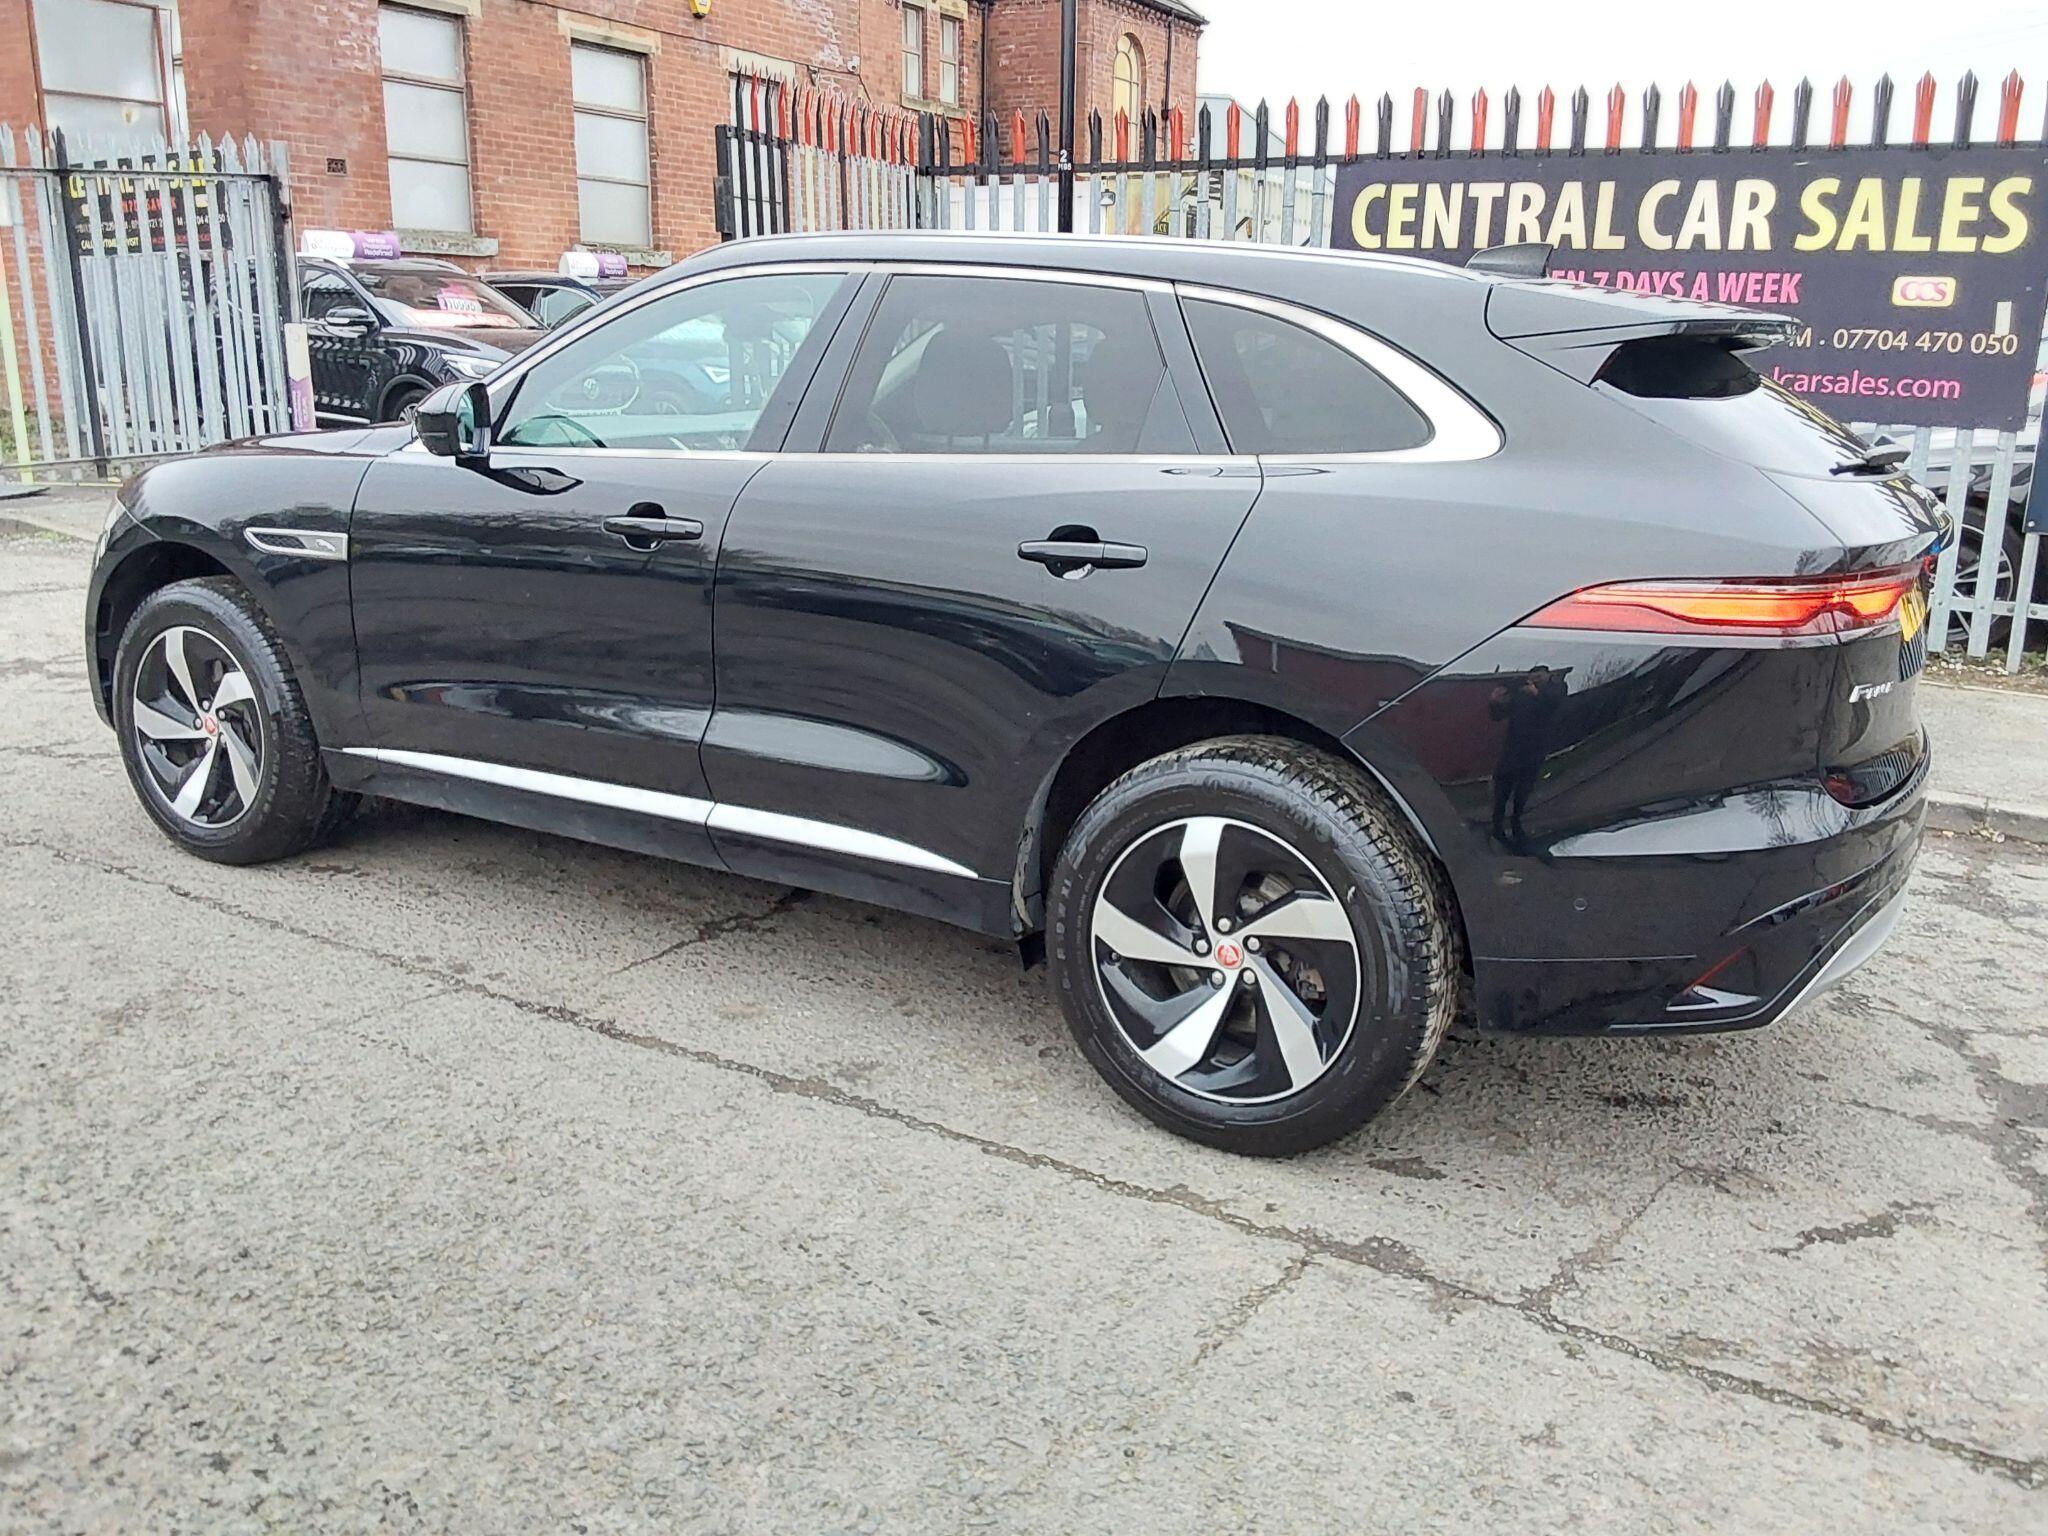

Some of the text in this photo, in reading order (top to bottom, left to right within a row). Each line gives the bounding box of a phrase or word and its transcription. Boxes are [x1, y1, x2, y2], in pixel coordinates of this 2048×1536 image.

[1060, 149, 1067, 162] 2
[1351, 177, 2033, 253] CENTRAL CAR SALES
[1690, 272, 1709, 302] A
[1718, 272, 1802, 304] WEEK
[1833, 328, 1908, 351] 07704
[1915, 331, 1963, 353] 470
[1970, 333, 2019, 355] 050
